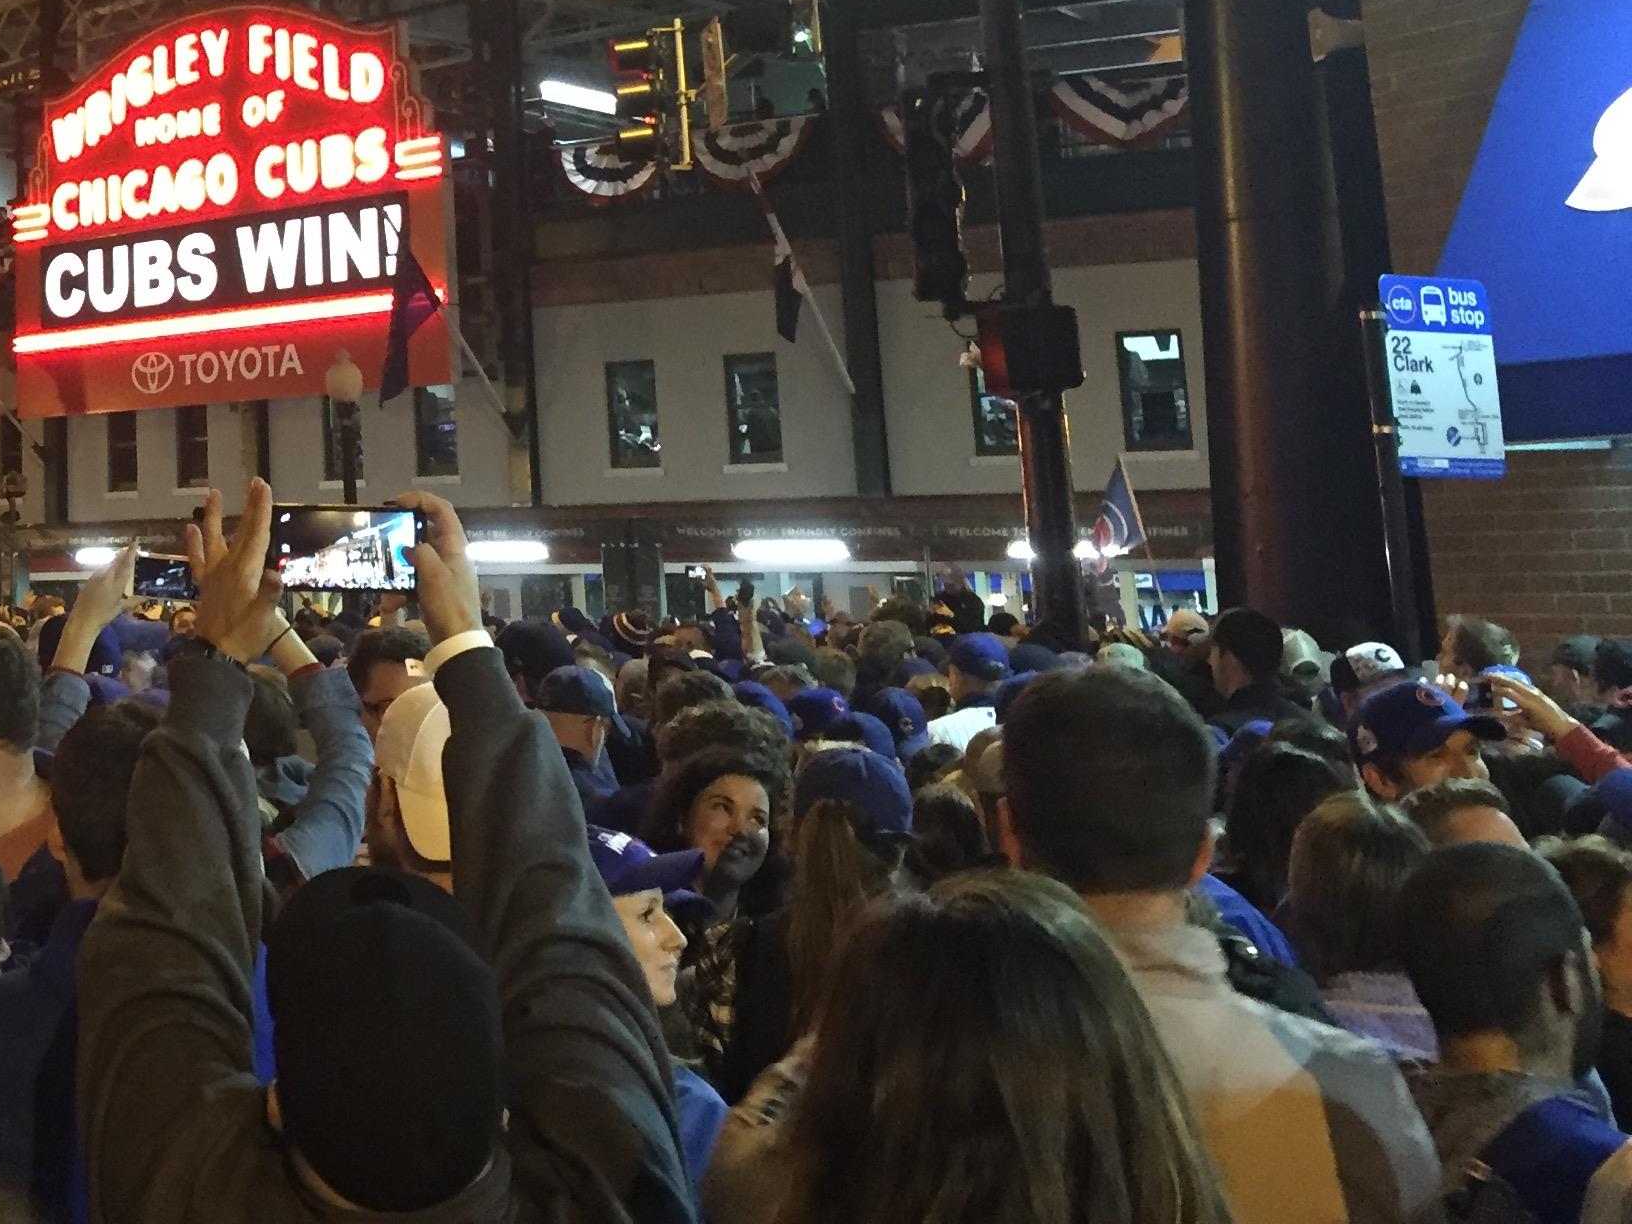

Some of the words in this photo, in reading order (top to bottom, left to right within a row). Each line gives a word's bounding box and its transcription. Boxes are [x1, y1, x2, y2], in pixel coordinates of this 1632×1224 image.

[50, 28, 230, 163] WRIGLEY
[247, 22, 385, 104] FIELD
[135, 103, 222, 147] HOME
[242, 89, 286, 128] OF
[52, 153, 239, 232] CHICAGO
[254, 127, 390, 200] CUBS
[44, 233, 217, 319] CUBS
[236, 203, 404, 295] WIN!
[1392, 297, 1413, 311] cta
[1448, 286, 1477, 305] bus
[1451, 307, 1485, 329] stop
[1390, 336, 1412, 355] 22
[179, 344, 304, 387] TOYOTA
[1393, 354, 1434, 373] Clark
[948, 527, 1009, 537] WELCOME
